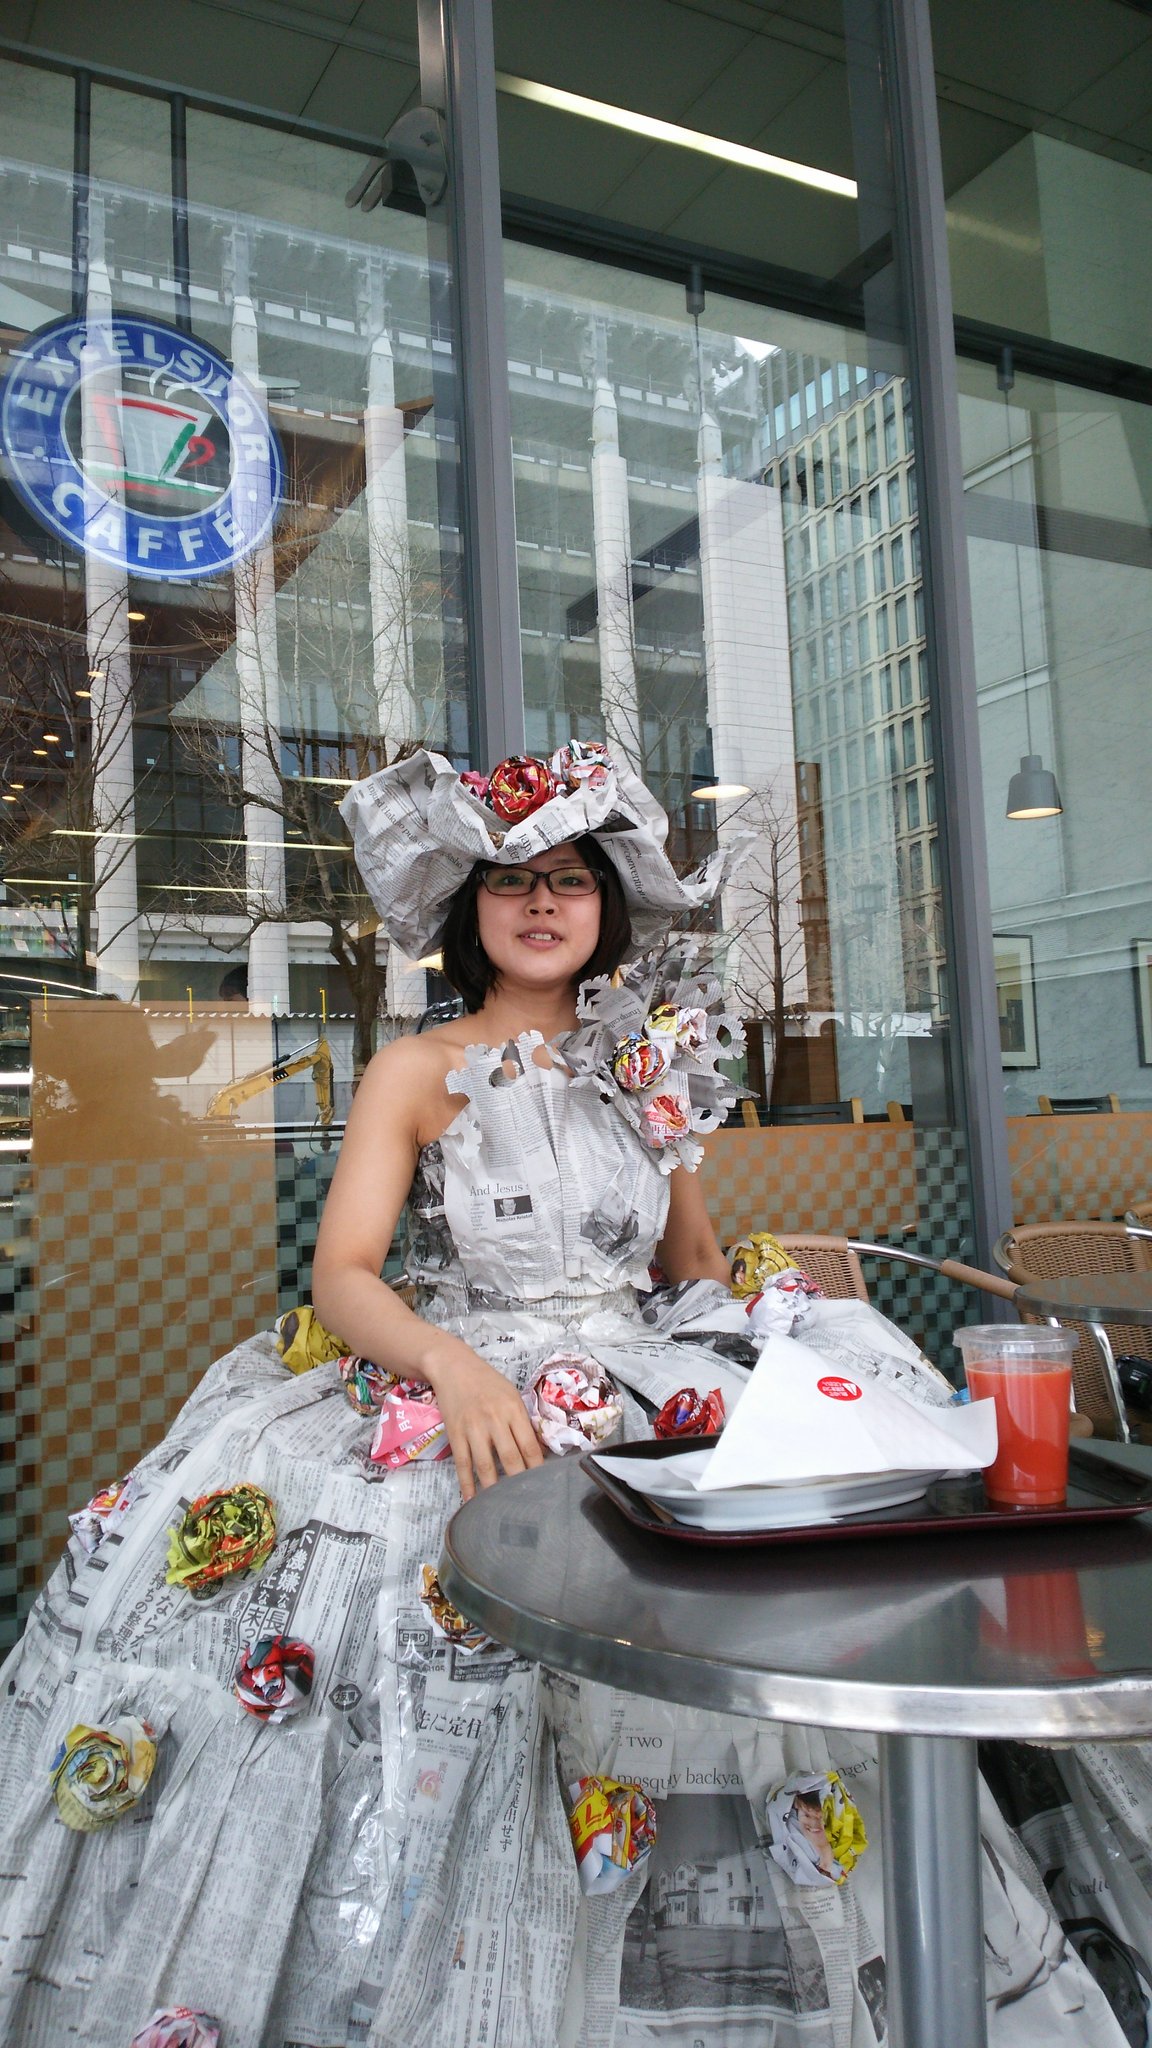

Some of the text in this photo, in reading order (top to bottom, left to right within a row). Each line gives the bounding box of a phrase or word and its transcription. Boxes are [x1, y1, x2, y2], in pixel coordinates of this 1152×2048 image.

[18, 328, 270, 463] EXCELSIOR
[505, 842, 521, 861] after
[470, 1183, 523, 1196] And Jesus
[402, 1633, 426, 1643] 日帰り
[627, 1736, 663, 1749] TWO
[836, 1761, 869, 1780] nger
